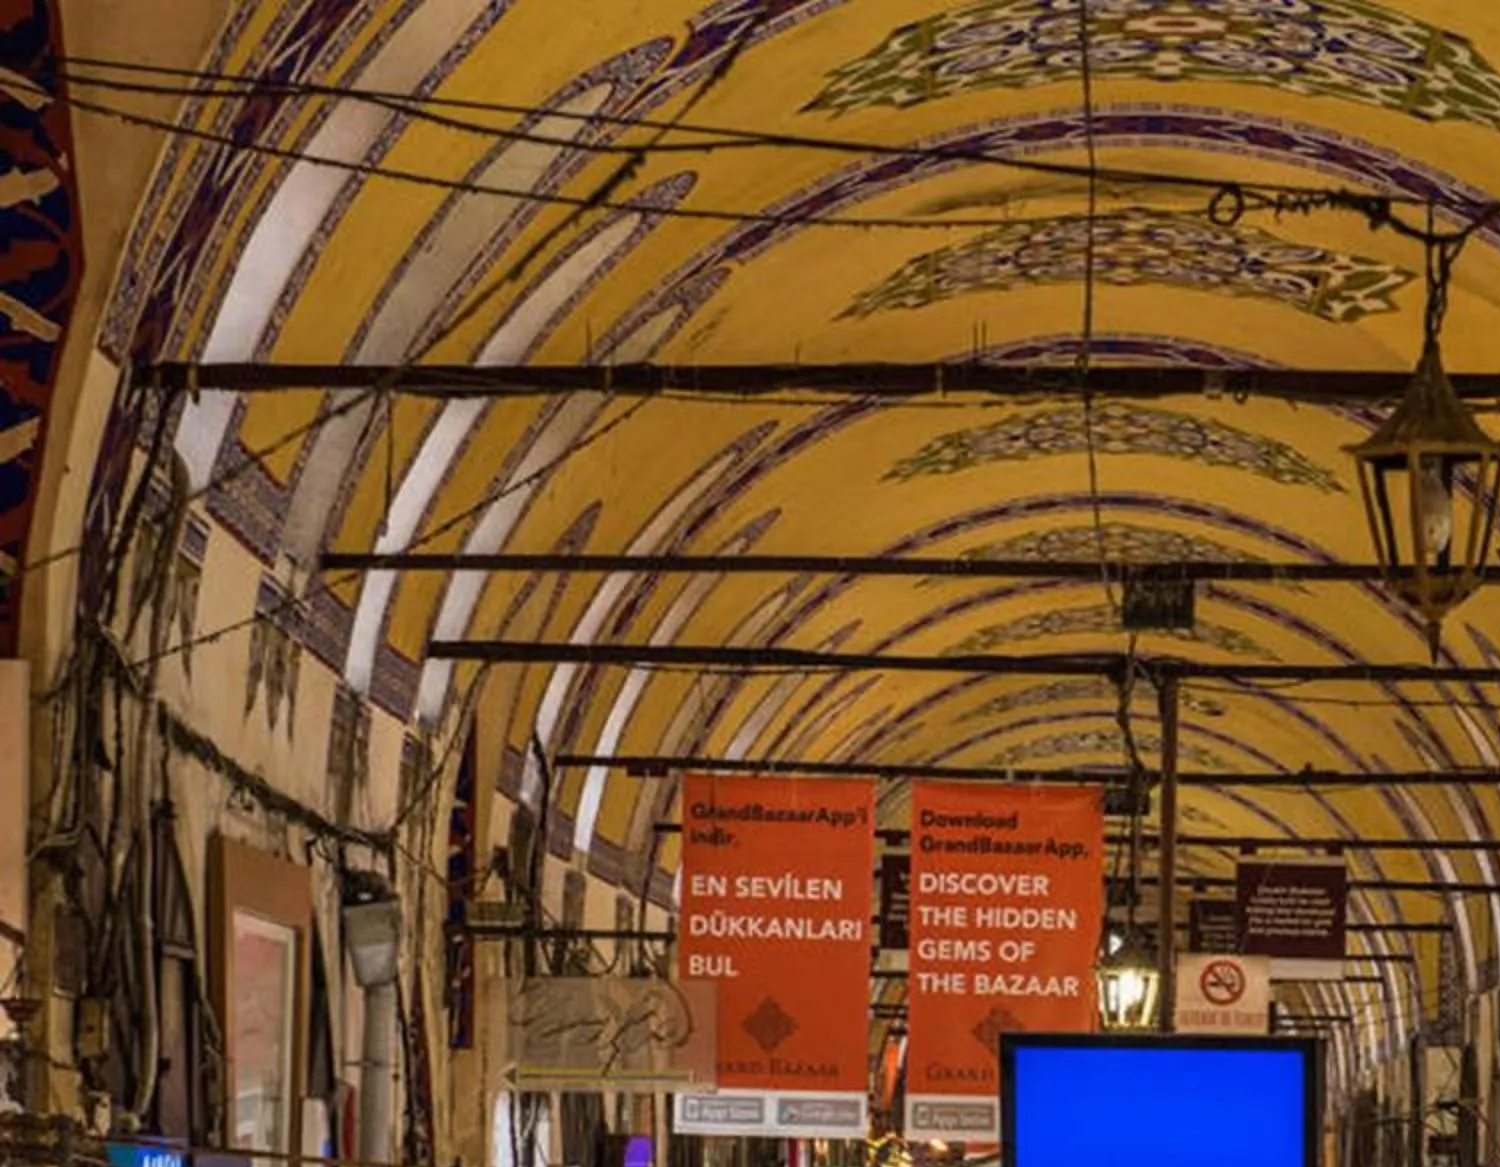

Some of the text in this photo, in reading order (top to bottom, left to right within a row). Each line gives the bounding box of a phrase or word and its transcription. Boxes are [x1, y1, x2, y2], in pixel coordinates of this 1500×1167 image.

[920, 810, 1018, 829] Download
[691, 872, 843, 900] EN SEVİLEN
[919, 872, 1049, 896] DISCOVER
[689, 909, 863, 941] DÜKKANLARI
[918, 905, 1078, 930] THE HIDDEN
[917, 938, 1036, 963] GEMS OF
[688, 954, 740, 977] BUL
[917, 972, 1080, 997] THE BAZAAR
